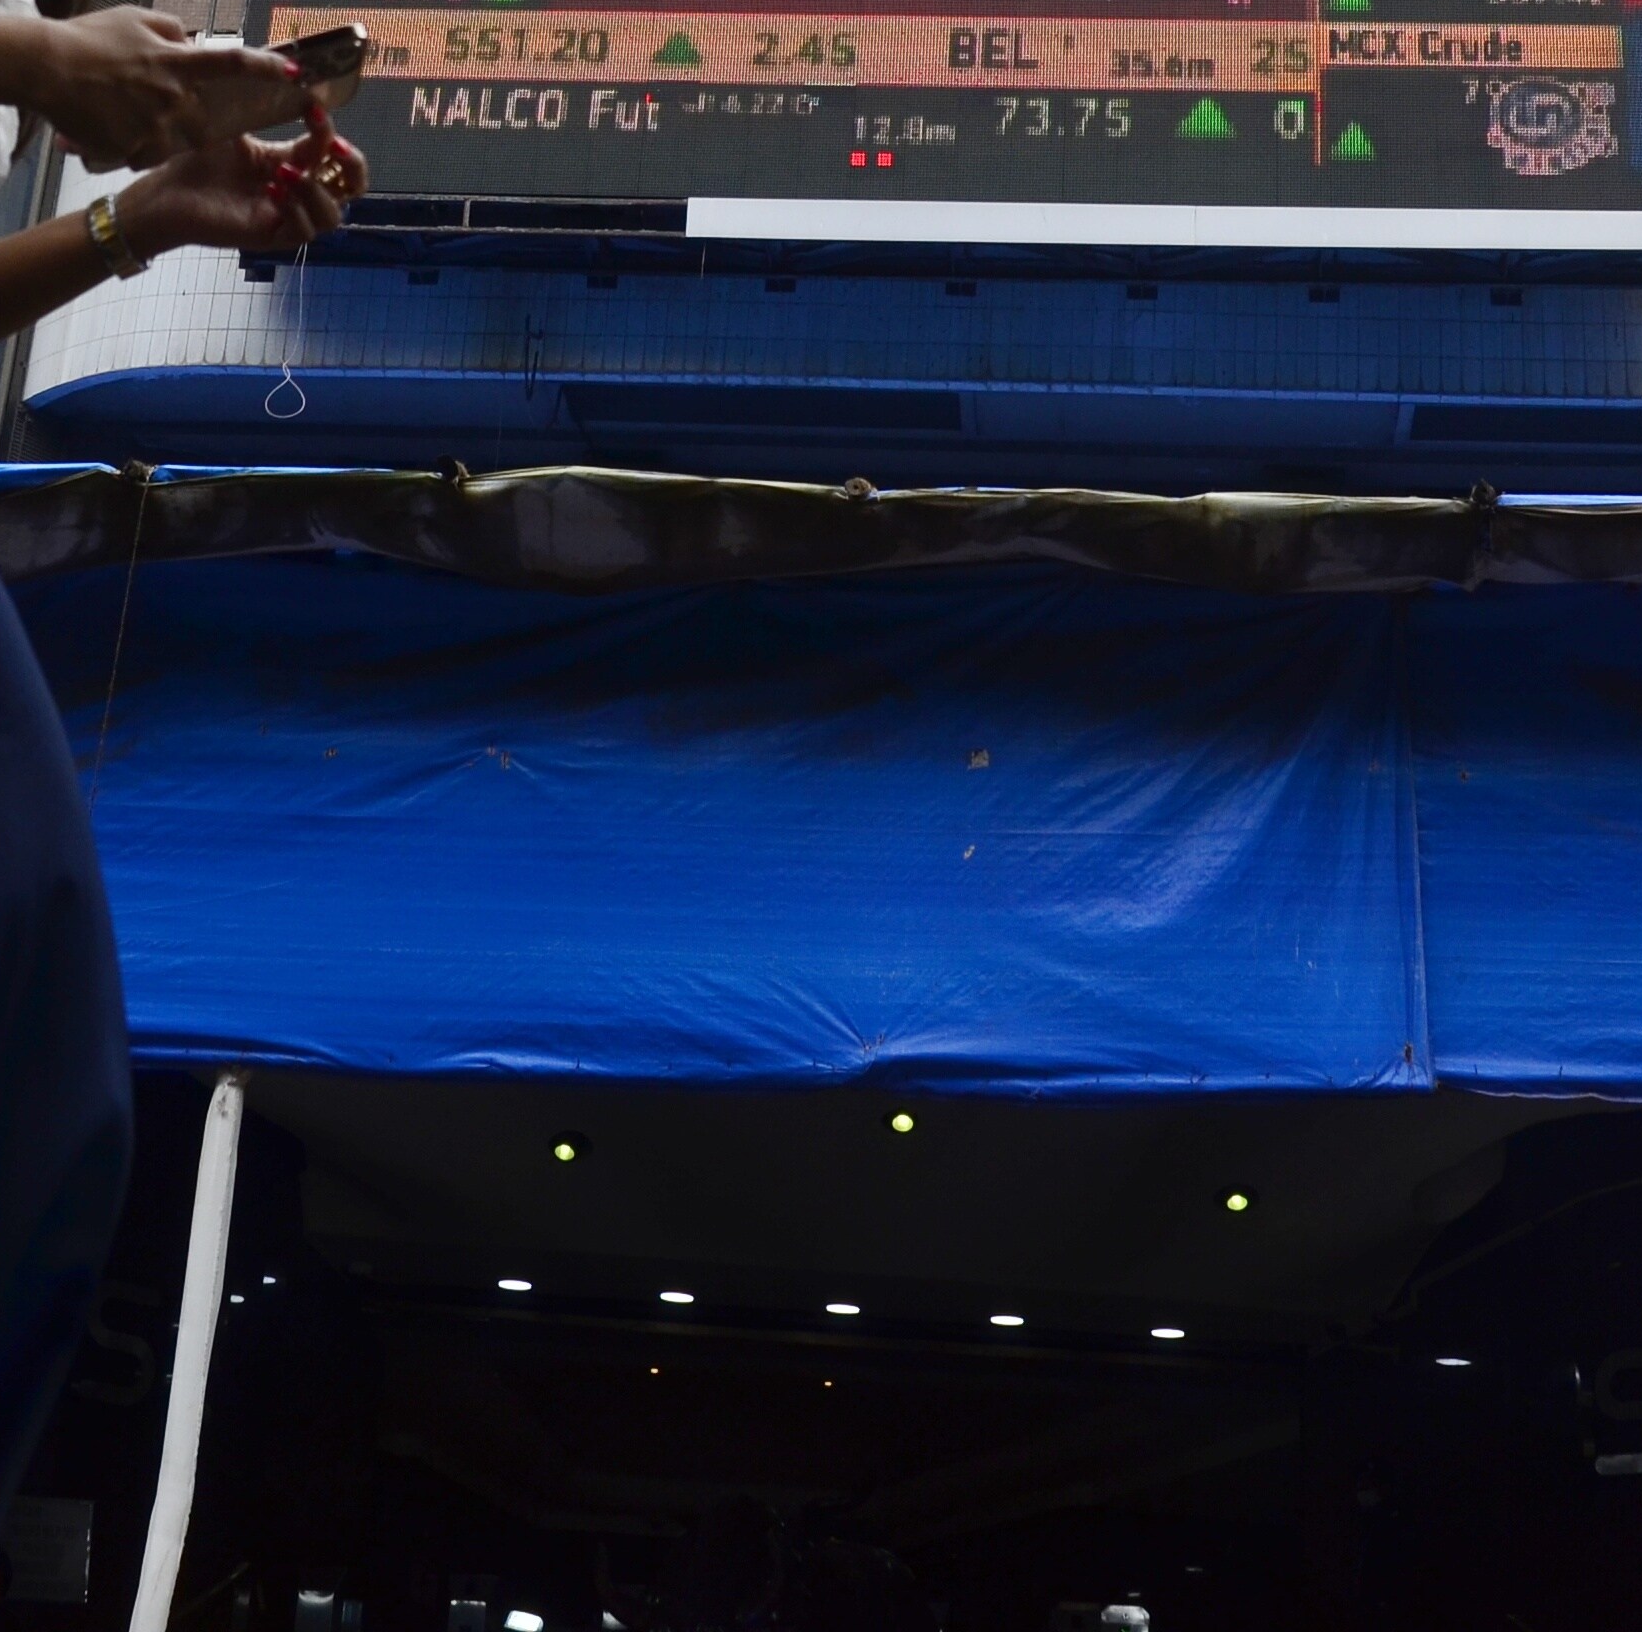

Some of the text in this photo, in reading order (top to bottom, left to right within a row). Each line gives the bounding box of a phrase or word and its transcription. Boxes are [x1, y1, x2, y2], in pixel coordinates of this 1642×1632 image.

[443, 27, 611, 64] 551.20
[753, 31, 858, 68] 2.45
[948, 26, 1041, 71] BEL
[1328, 29, 1523, 62] MCX Crude
[410, 86, 569, 131] NALCO
[587, 87, 660, 132] Fut
[993, 96, 1131, 139] 73.75
